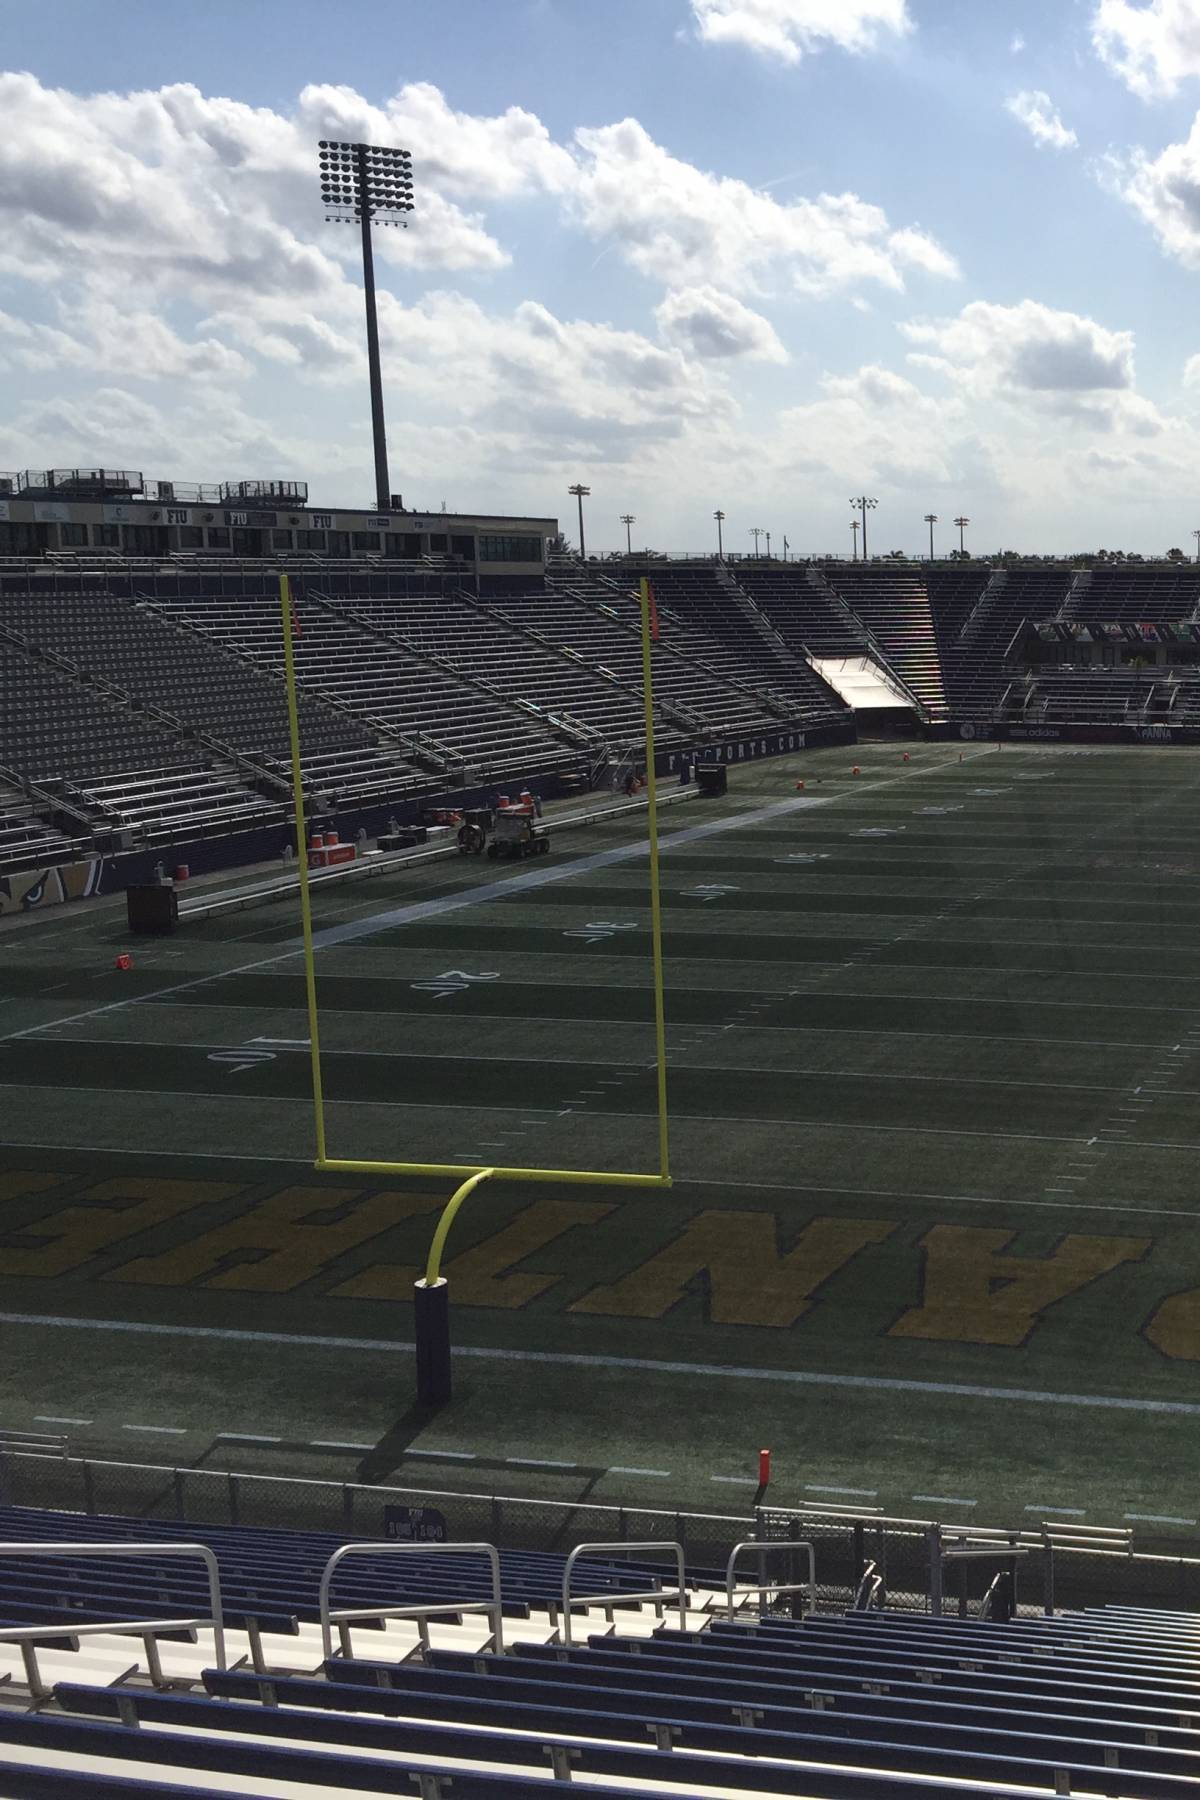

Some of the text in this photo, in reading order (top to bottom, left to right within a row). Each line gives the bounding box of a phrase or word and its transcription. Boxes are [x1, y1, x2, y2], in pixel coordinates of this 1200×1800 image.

[167, 509, 188, 524] FIU
[230, 511, 248, 525] FIU
[313, 515, 332, 529] FIU
[1028, 728, 1060, 738] adidas
